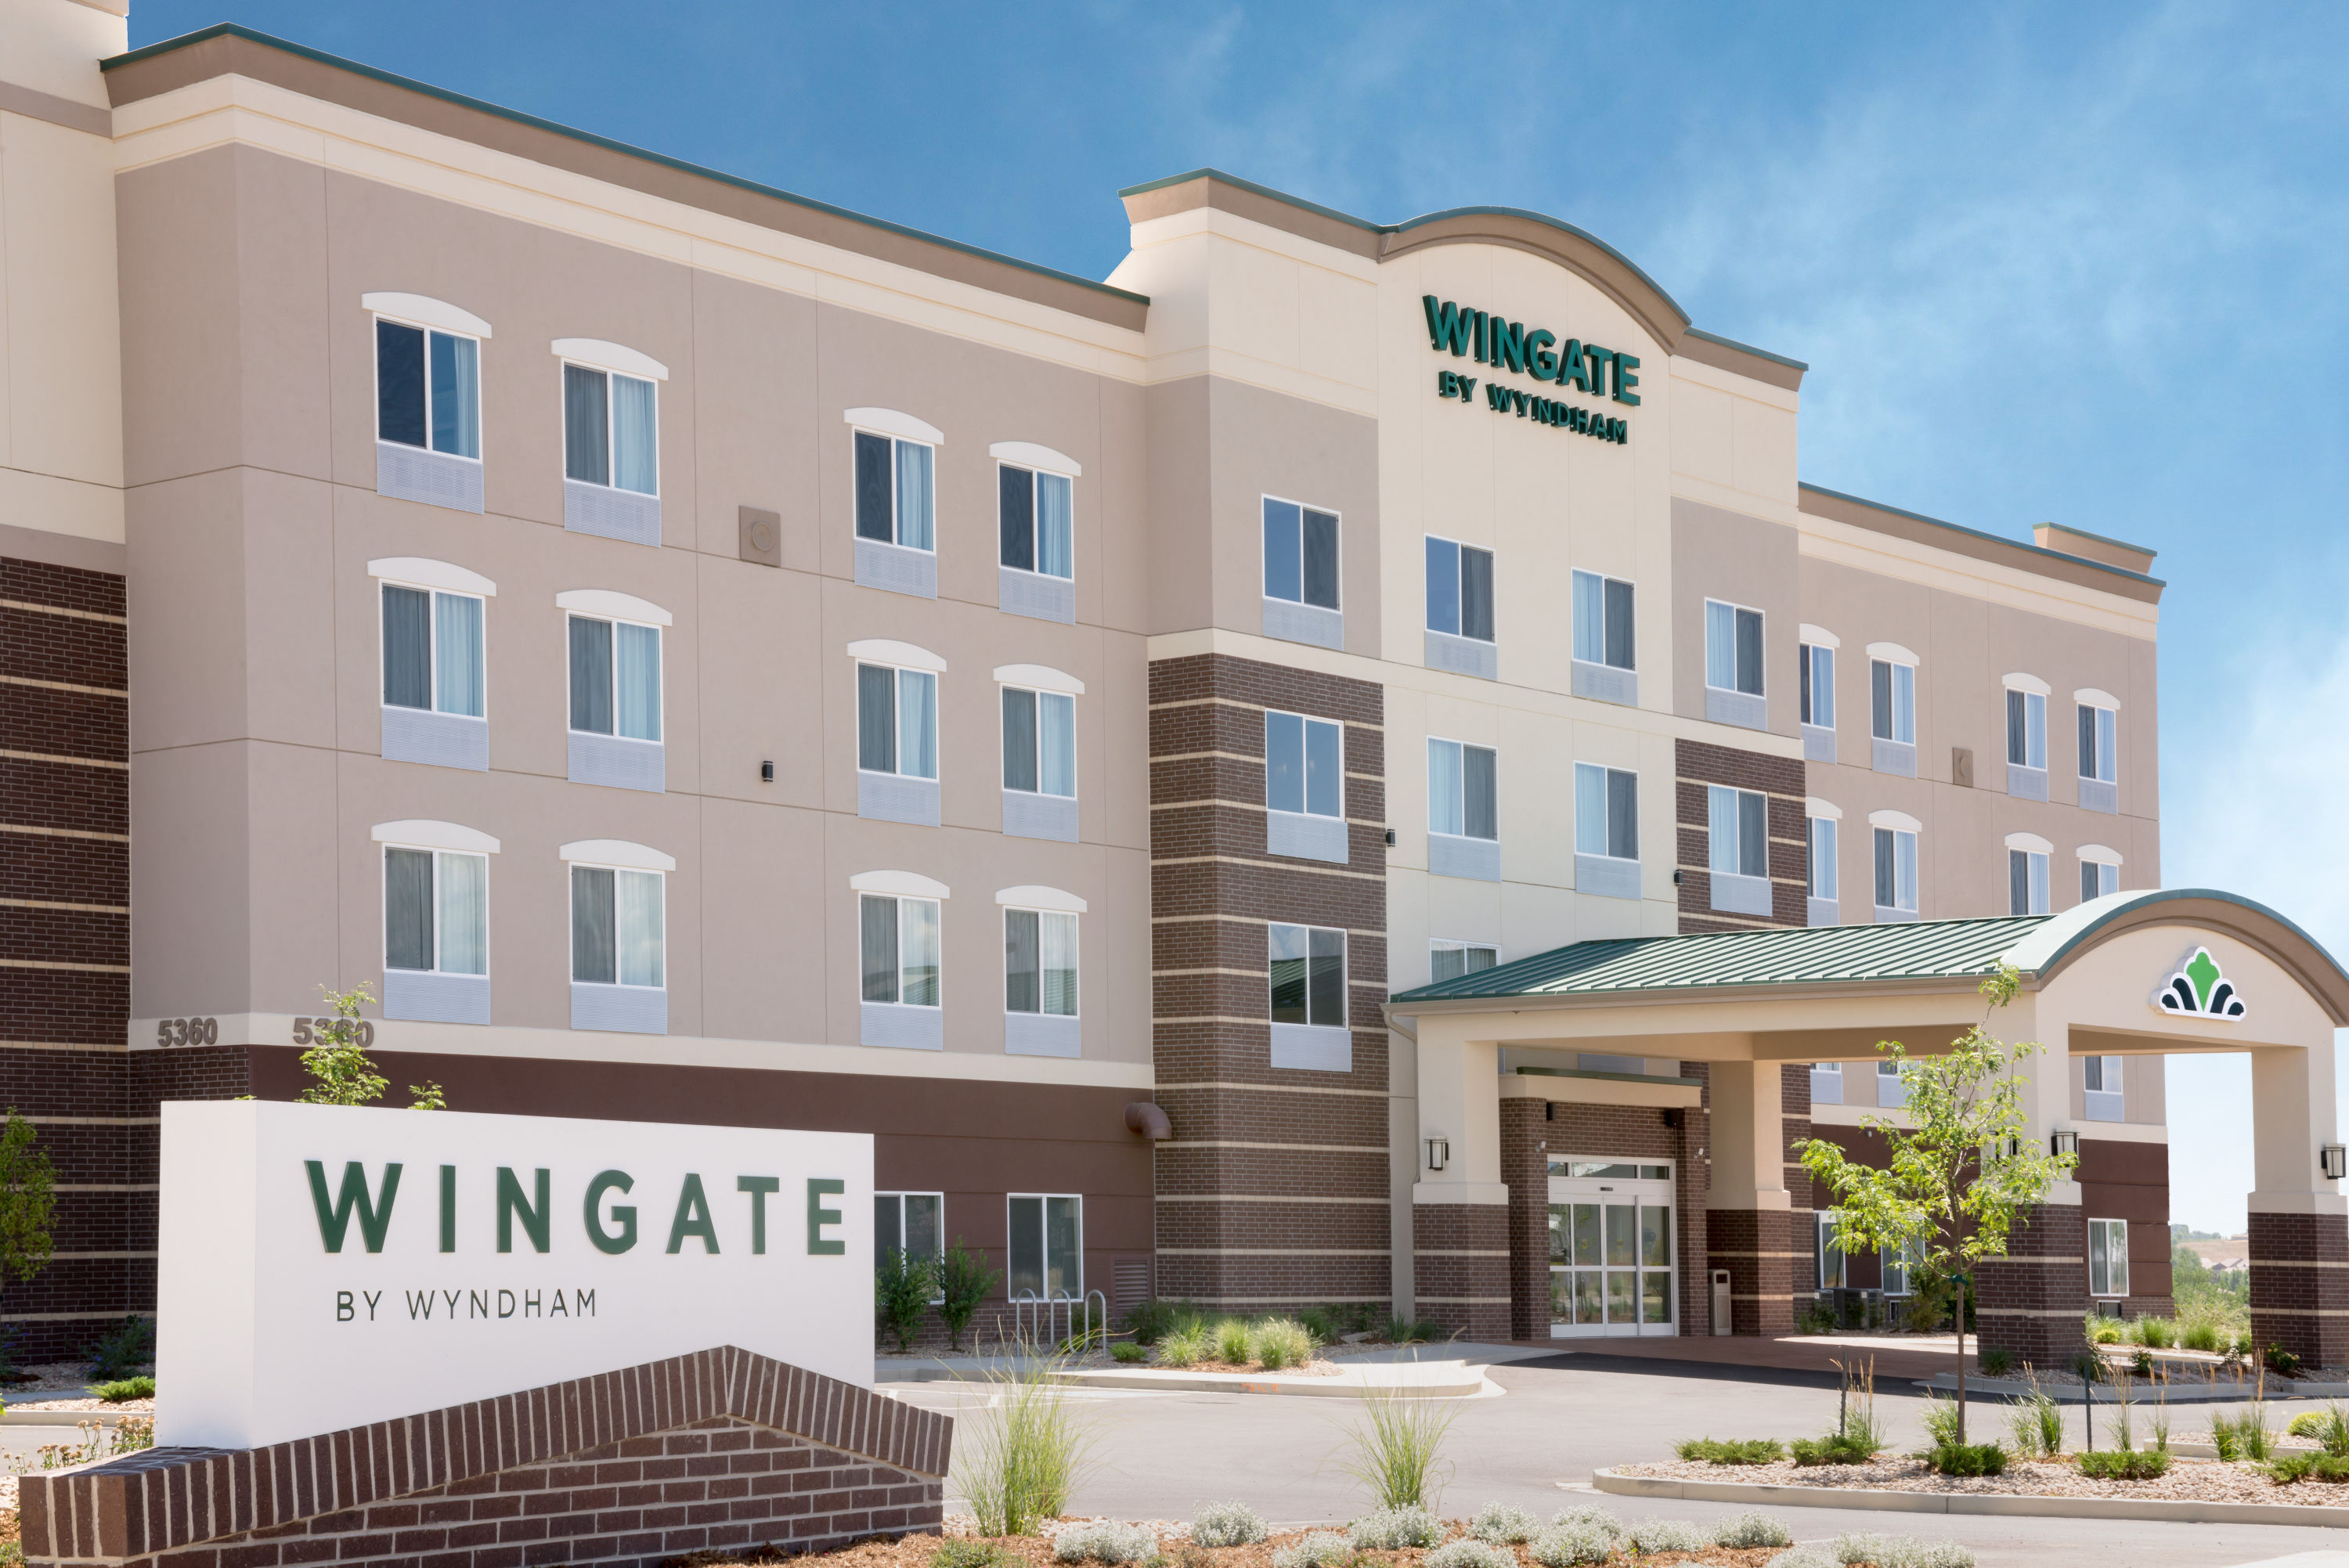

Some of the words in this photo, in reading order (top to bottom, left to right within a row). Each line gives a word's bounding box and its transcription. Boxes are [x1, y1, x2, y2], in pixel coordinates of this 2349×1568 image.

[1422, 294, 1641, 406] WINGATE
[1438, 370, 1478, 403] BY
[1485, 383, 1628, 445] WYNDHAM
[157, 1017, 218, 1047] 5360
[304, 1159, 846, 1256] WINGATE
[336, 1290, 382, 1322] BY
[406, 1288, 597, 1321] WYNDHAM
